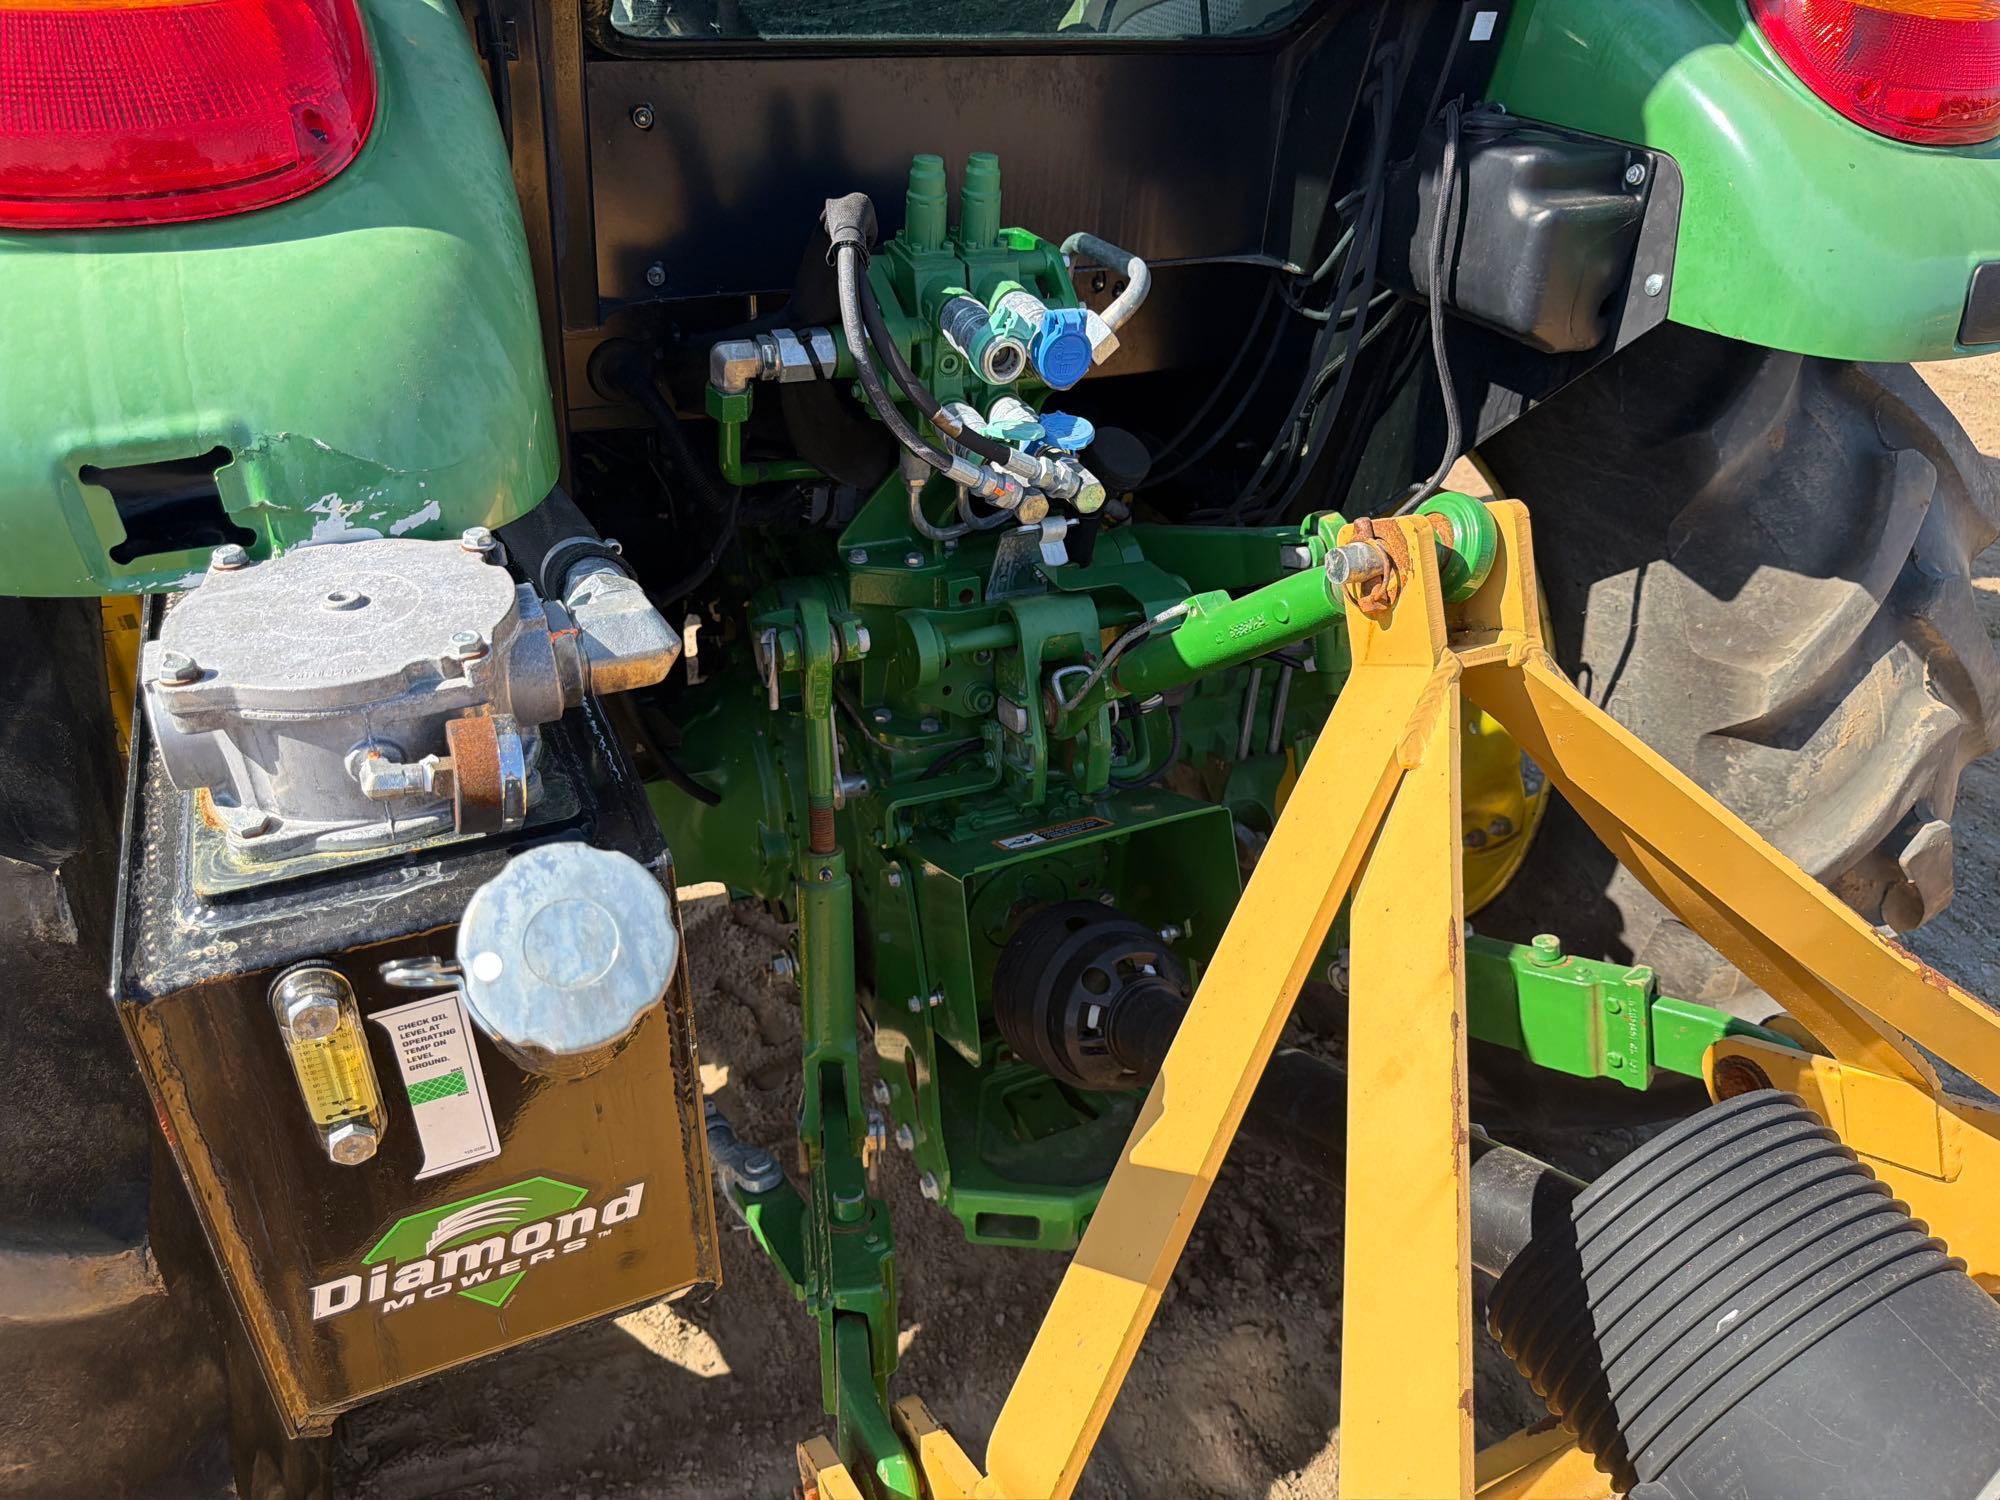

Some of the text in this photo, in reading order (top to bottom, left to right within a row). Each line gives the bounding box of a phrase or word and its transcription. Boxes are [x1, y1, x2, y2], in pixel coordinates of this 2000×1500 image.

[397, 1013, 449, 1032] CHECK OIL
[399, 1024, 441, 1040] LEVEL AT
[402, 1027, 457, 1048] OPERATING
[404, 1039, 447, 1056] TEMP ON
[406, 1052, 434, 1064] LEVEL
[408, 1056, 451, 1072] GROUND.
[309, 1182, 645, 1321] Diamond
[383, 1237, 588, 1313] MOWERS
